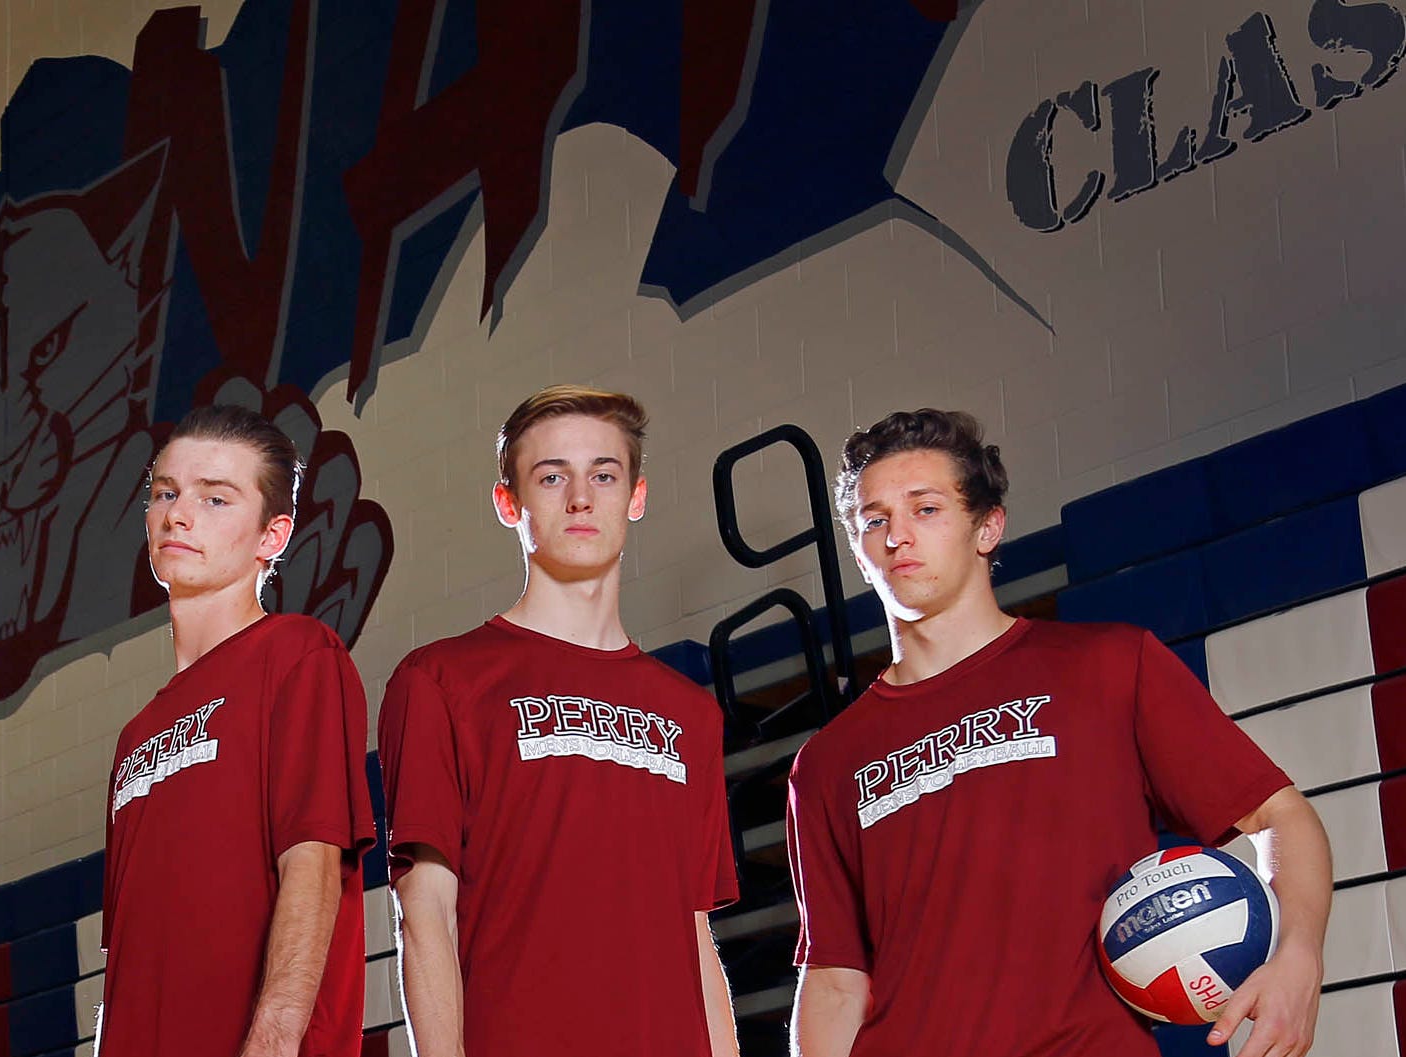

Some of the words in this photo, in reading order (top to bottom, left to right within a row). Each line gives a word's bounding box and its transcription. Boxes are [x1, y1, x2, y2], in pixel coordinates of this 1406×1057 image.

[1005, 0, 1406, 232] CLAS
[509, 694, 683, 761] PERRY
[854, 695, 1051, 808] PERRY
[917, 741, 1051, 792] VOLEYBALL
[1115, 883, 1213, 943] molten
[1116, 884, 1139, 908] Pro
[1141, 862, 1193, 888] Touch
